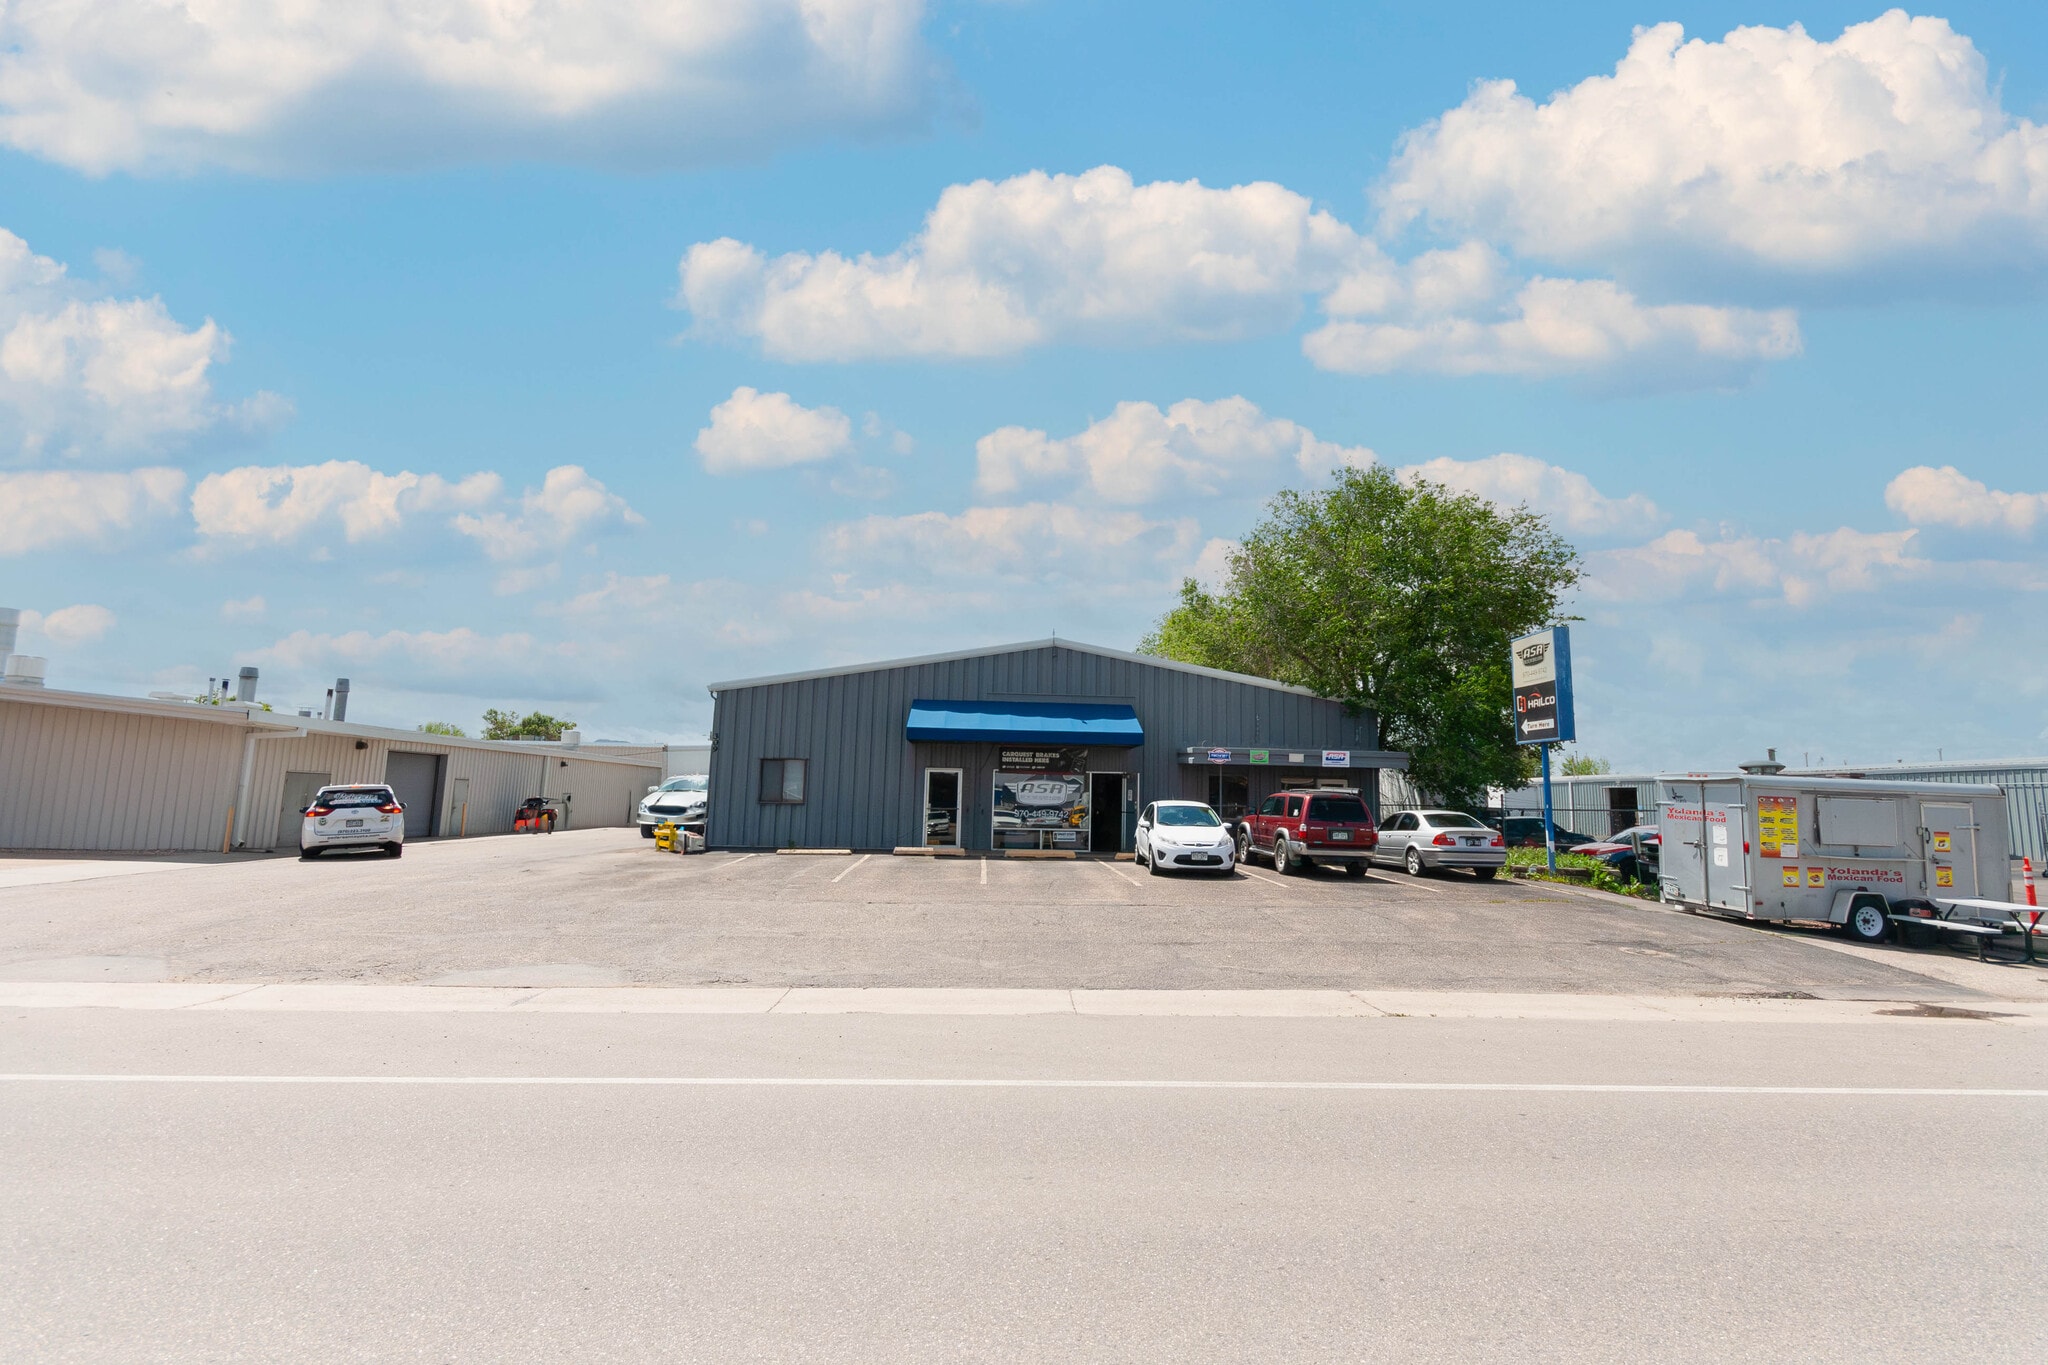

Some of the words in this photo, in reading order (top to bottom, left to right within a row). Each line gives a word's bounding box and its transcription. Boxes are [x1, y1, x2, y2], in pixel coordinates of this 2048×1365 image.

[1524, 645, 1543, 658] ASA
[1528, 696, 1555, 709] HAILCO
[1021, 783, 1064, 794] ASA
[1014, 810, 1069, 818] 970-449-9742
[1667, 813, 1702, 822] Mexican
[1827, 874, 1874, 882] Mexican
